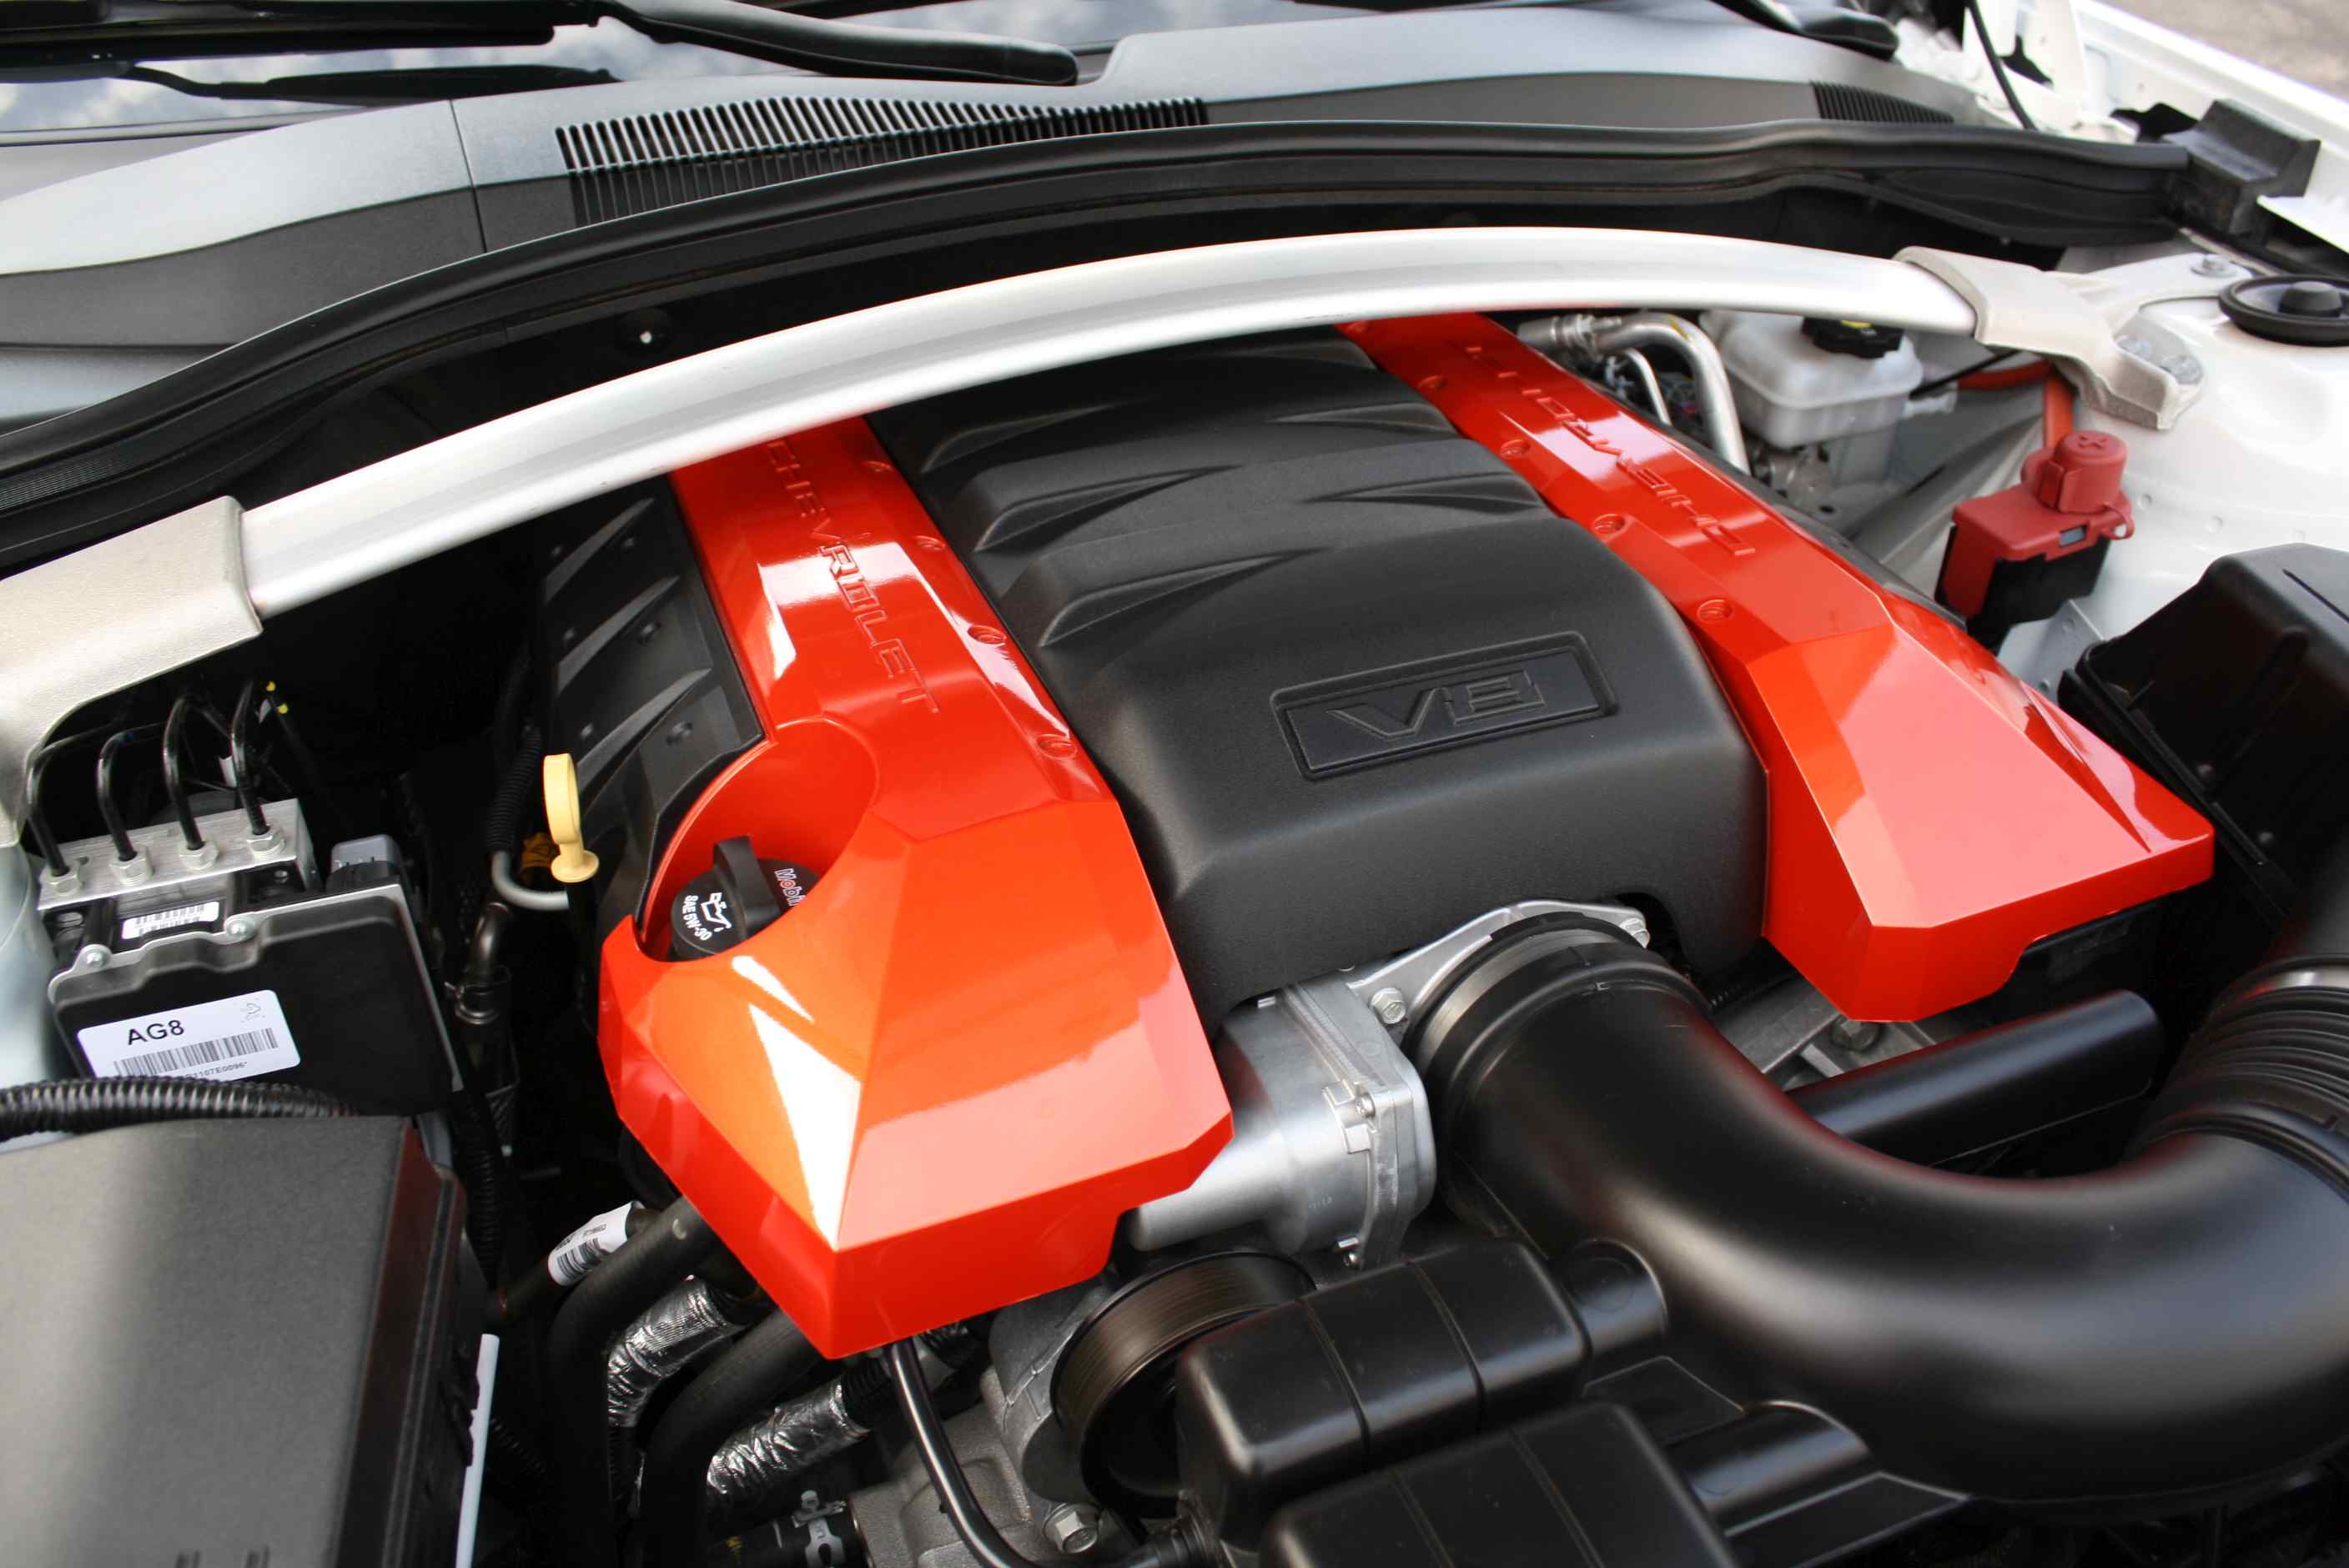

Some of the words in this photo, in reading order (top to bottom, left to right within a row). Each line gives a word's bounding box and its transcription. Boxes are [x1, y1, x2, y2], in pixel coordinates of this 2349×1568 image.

[765, 440, 940, 714] CHEVROLET
[1325, 669, 1546, 741] V8
[682, 895, 699, 914] SAE
[683, 913, 713, 941] 5W-30
[128, 1019, 184, 1046] AG8
